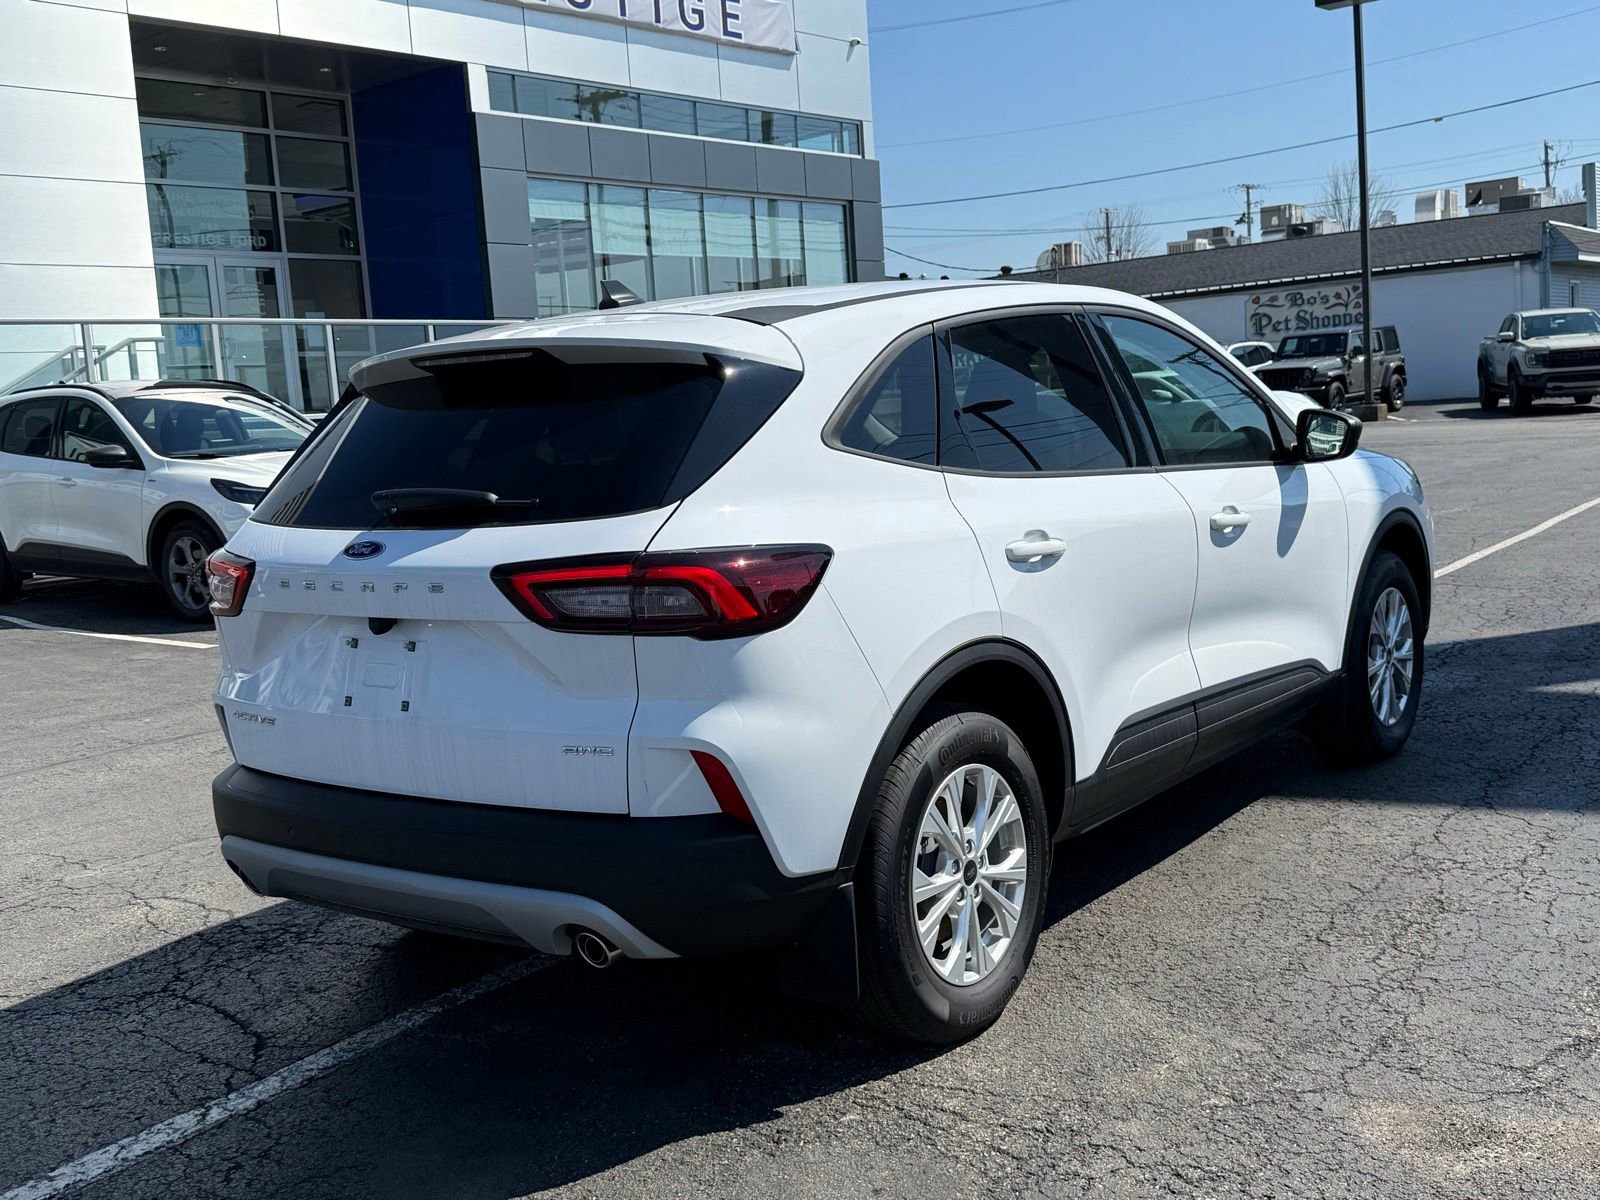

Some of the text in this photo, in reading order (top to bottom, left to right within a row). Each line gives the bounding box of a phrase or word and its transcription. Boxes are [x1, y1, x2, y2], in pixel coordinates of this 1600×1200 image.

[230, 234, 267, 248] FORD
[1285, 291, 1330, 309] Bo's
[1250, 309, 1364, 337] Pet Shoppe
[279, 578, 444, 594] ESCAPE
[231, 710, 276, 726] ACTIVE
[562, 745, 614, 757] AWD
